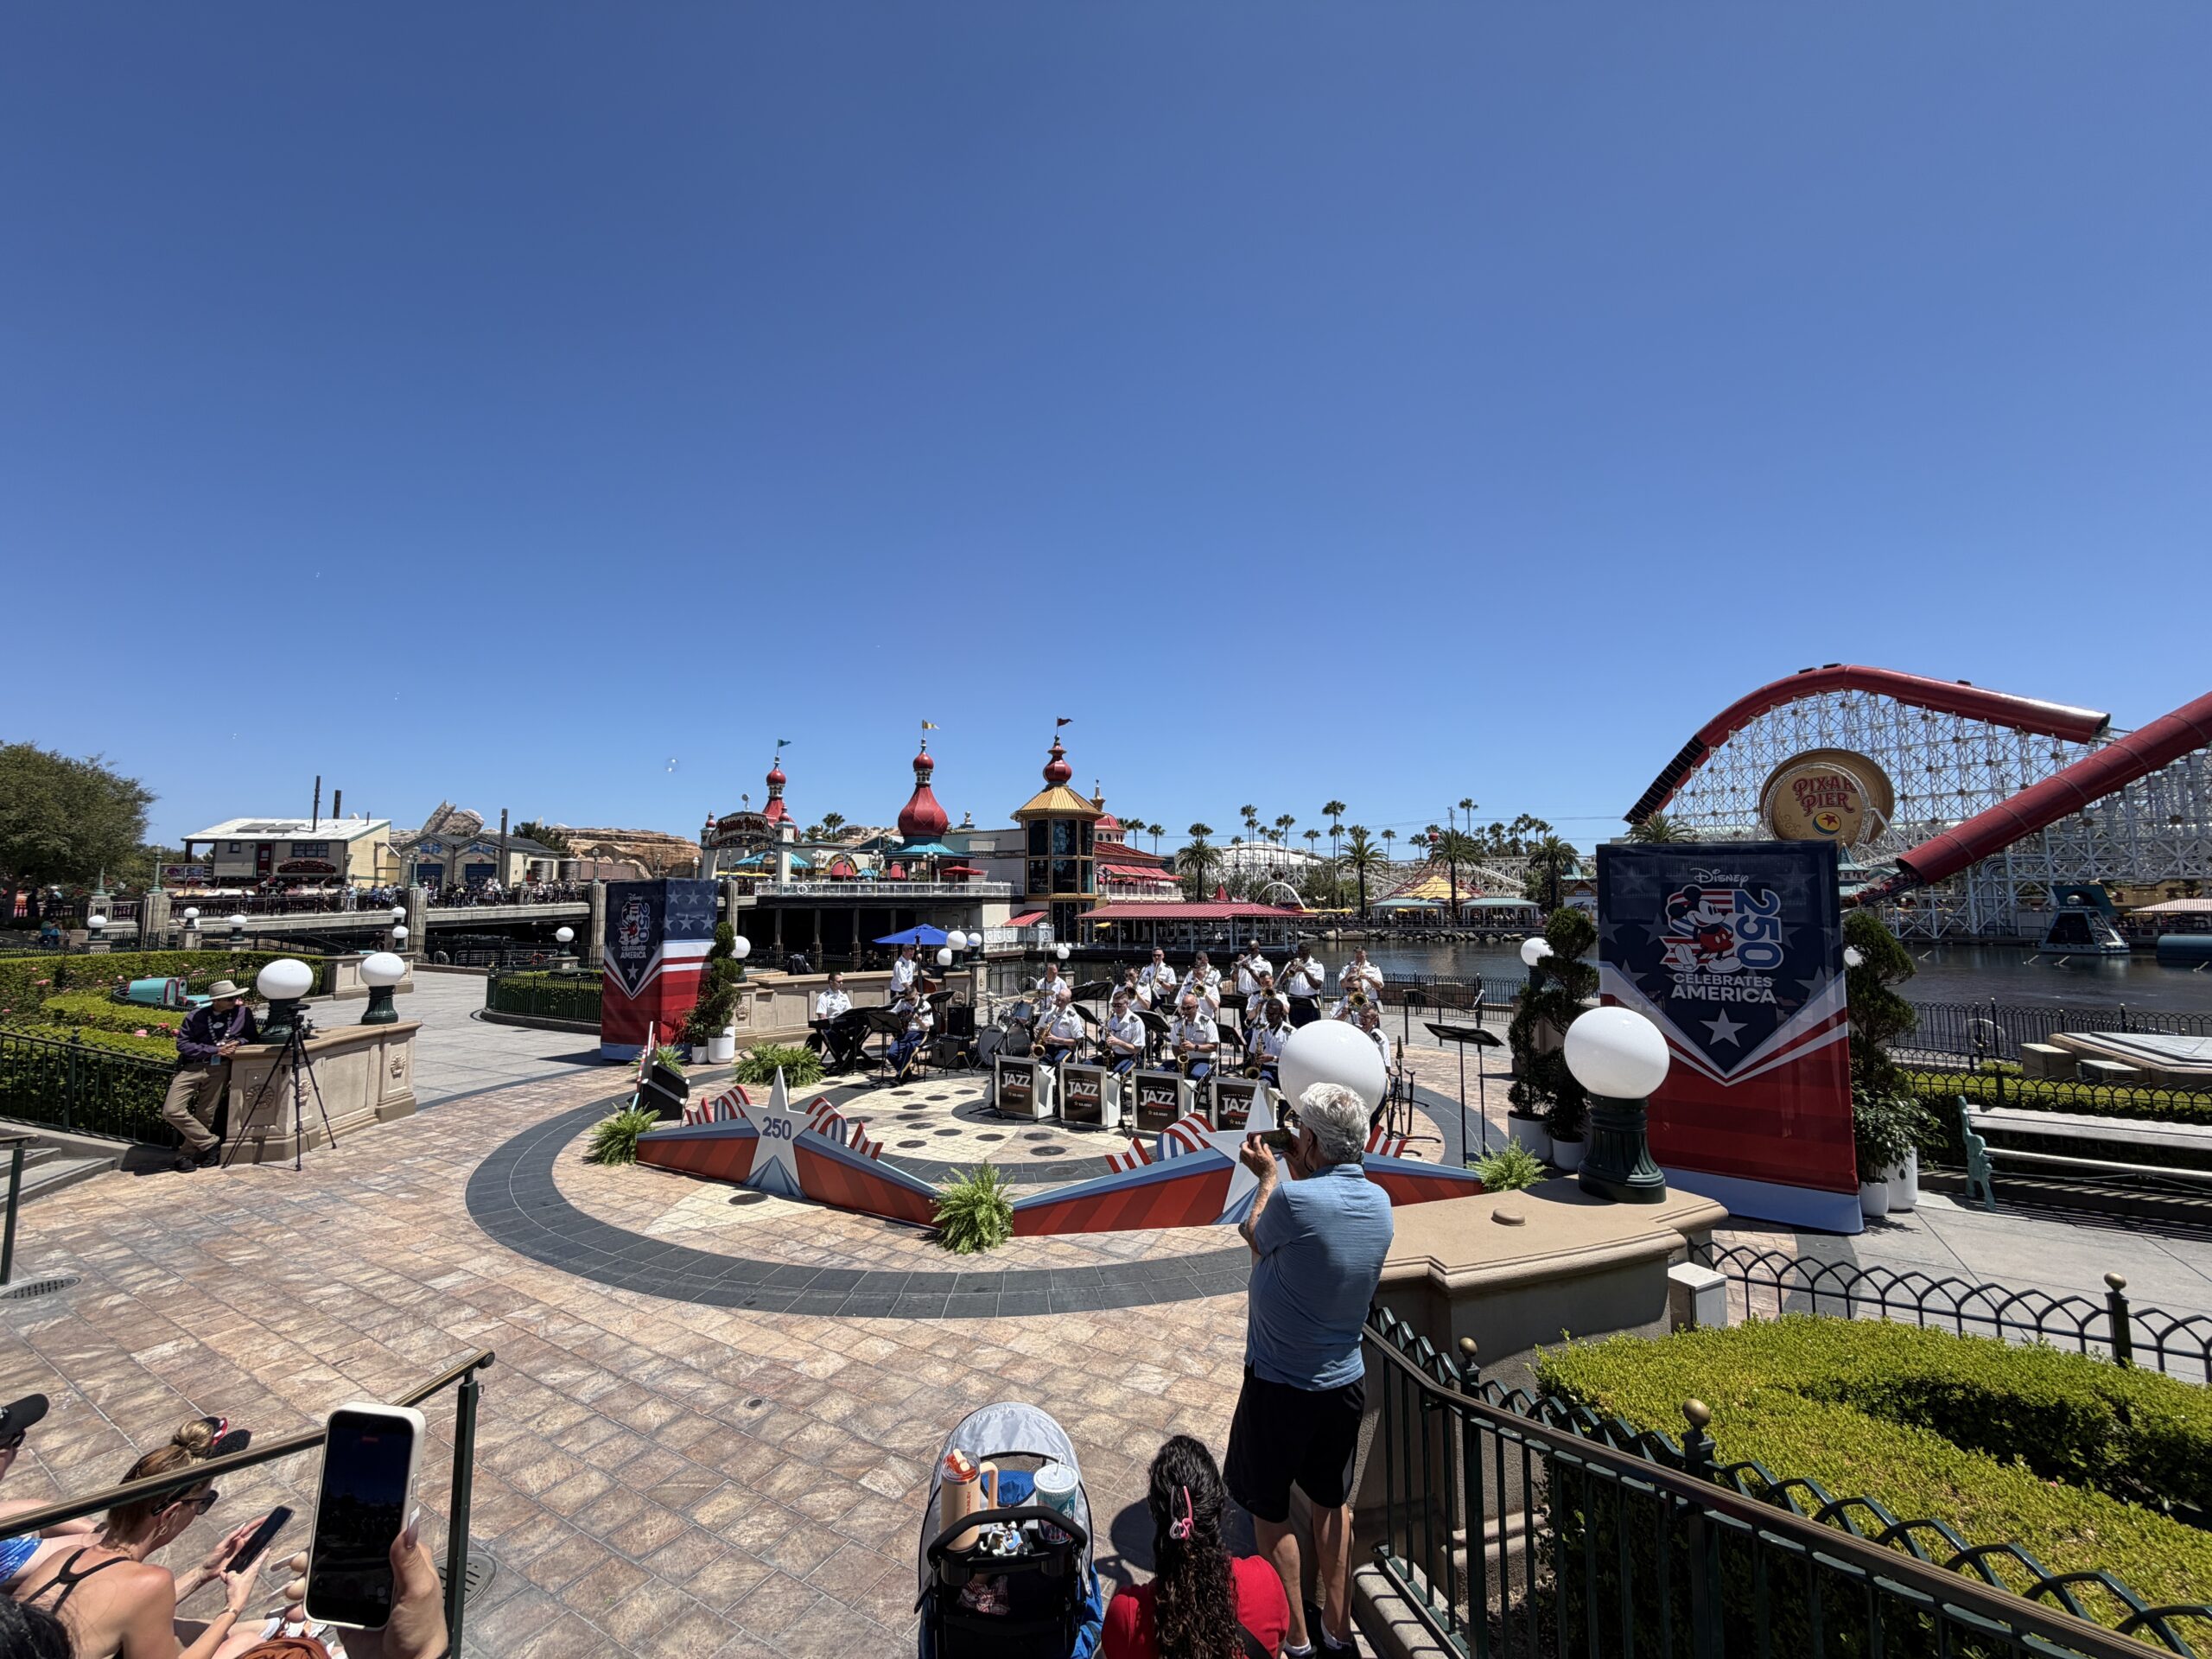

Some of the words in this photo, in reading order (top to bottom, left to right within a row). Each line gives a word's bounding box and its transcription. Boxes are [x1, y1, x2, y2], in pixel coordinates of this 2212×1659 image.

[1792, 776, 1858, 801] PIXAR
[1802, 792, 1855, 817] PIER
[1690, 868, 1749, 887] Disney
[638, 903, 650, 943] 250
[1734, 888, 1784, 969] 250
[1673, 973, 1773, 988] CELEBRATES
[1670, 984, 1777, 1004] AMERICA
[1001, 1072, 1031, 1089] JAZZ
[1066, 1081, 1099, 1097] JAZZ
[1140, 1089, 1175, 1106] JAZZ
[1220, 1097, 1253, 1115] JAZ
[762, 1116, 792, 1141] 250
